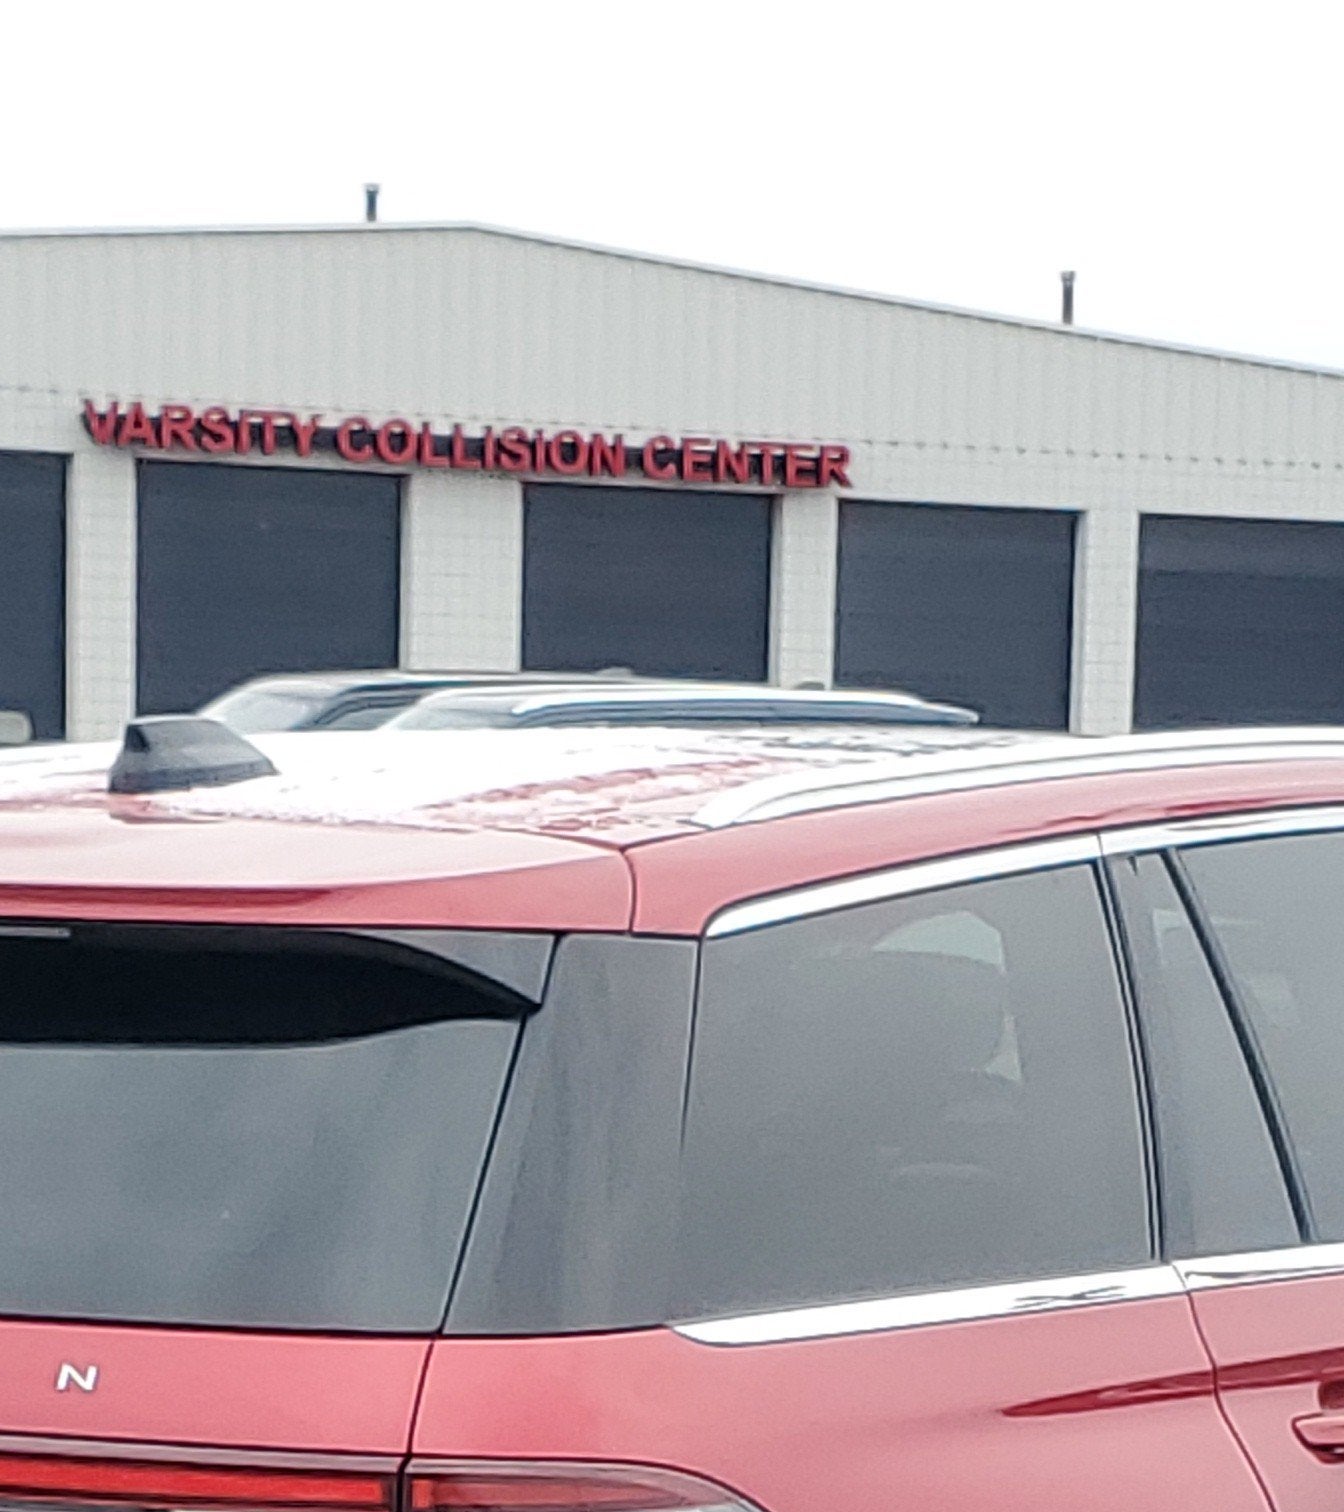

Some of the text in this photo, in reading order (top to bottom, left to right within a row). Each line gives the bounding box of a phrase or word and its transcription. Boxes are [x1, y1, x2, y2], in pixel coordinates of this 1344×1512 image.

[83, 400, 852, 488] VARSITY COLLISION CENTER
